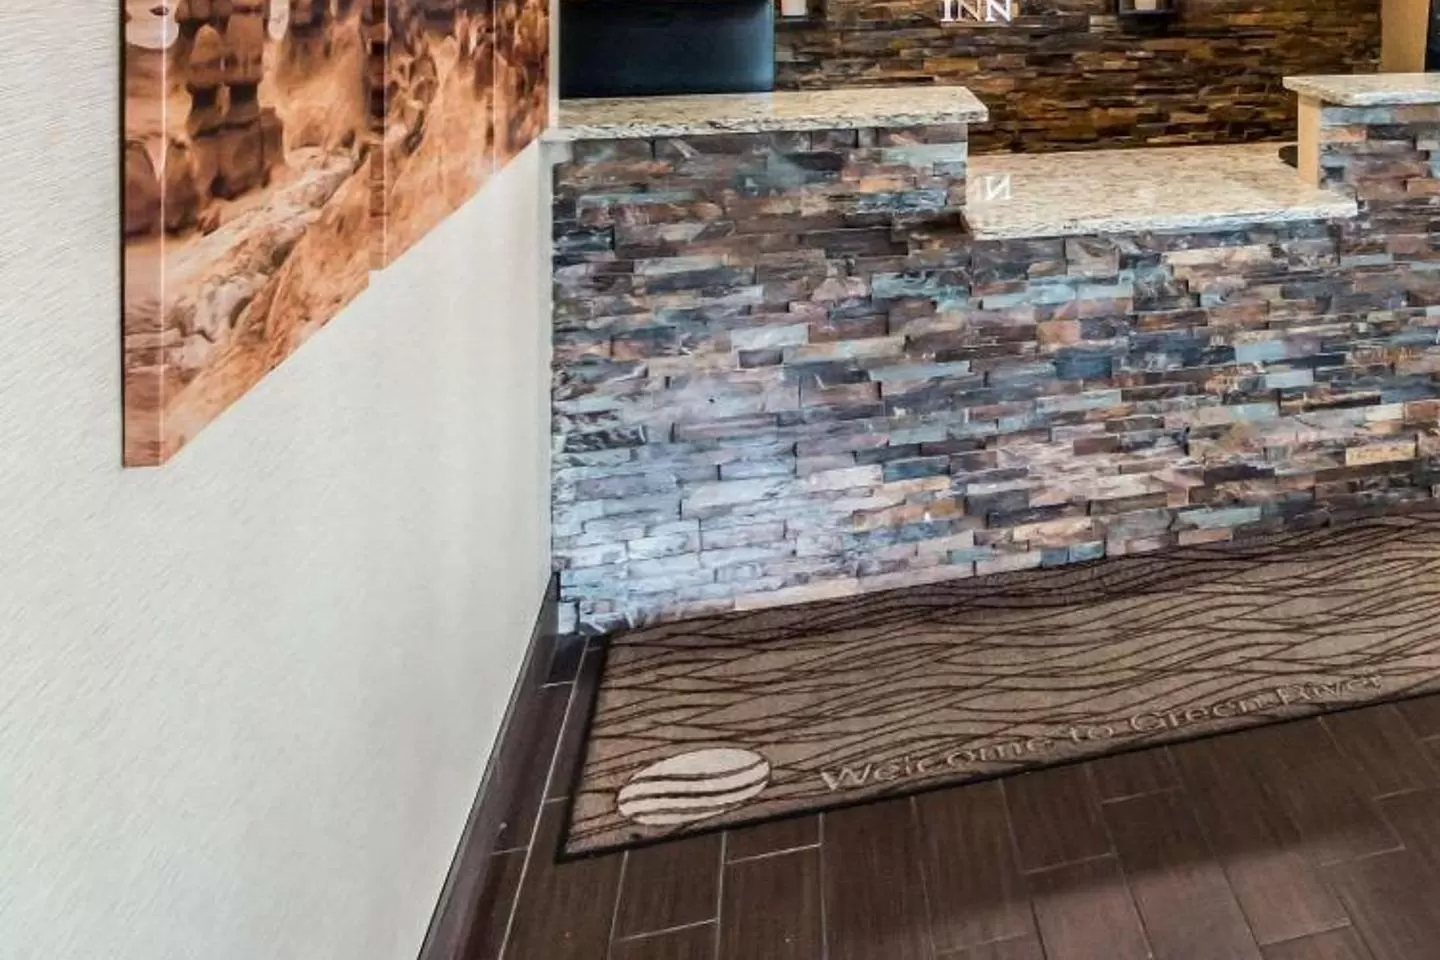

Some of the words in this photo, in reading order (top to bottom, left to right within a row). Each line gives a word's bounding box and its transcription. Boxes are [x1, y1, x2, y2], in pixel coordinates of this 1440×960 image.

[820, 737, 1055, 790] Welcome
[1068, 725, 1114, 742] to
[1129, 696, 1262, 732] Green
[1275, 675, 1383, 705] River
